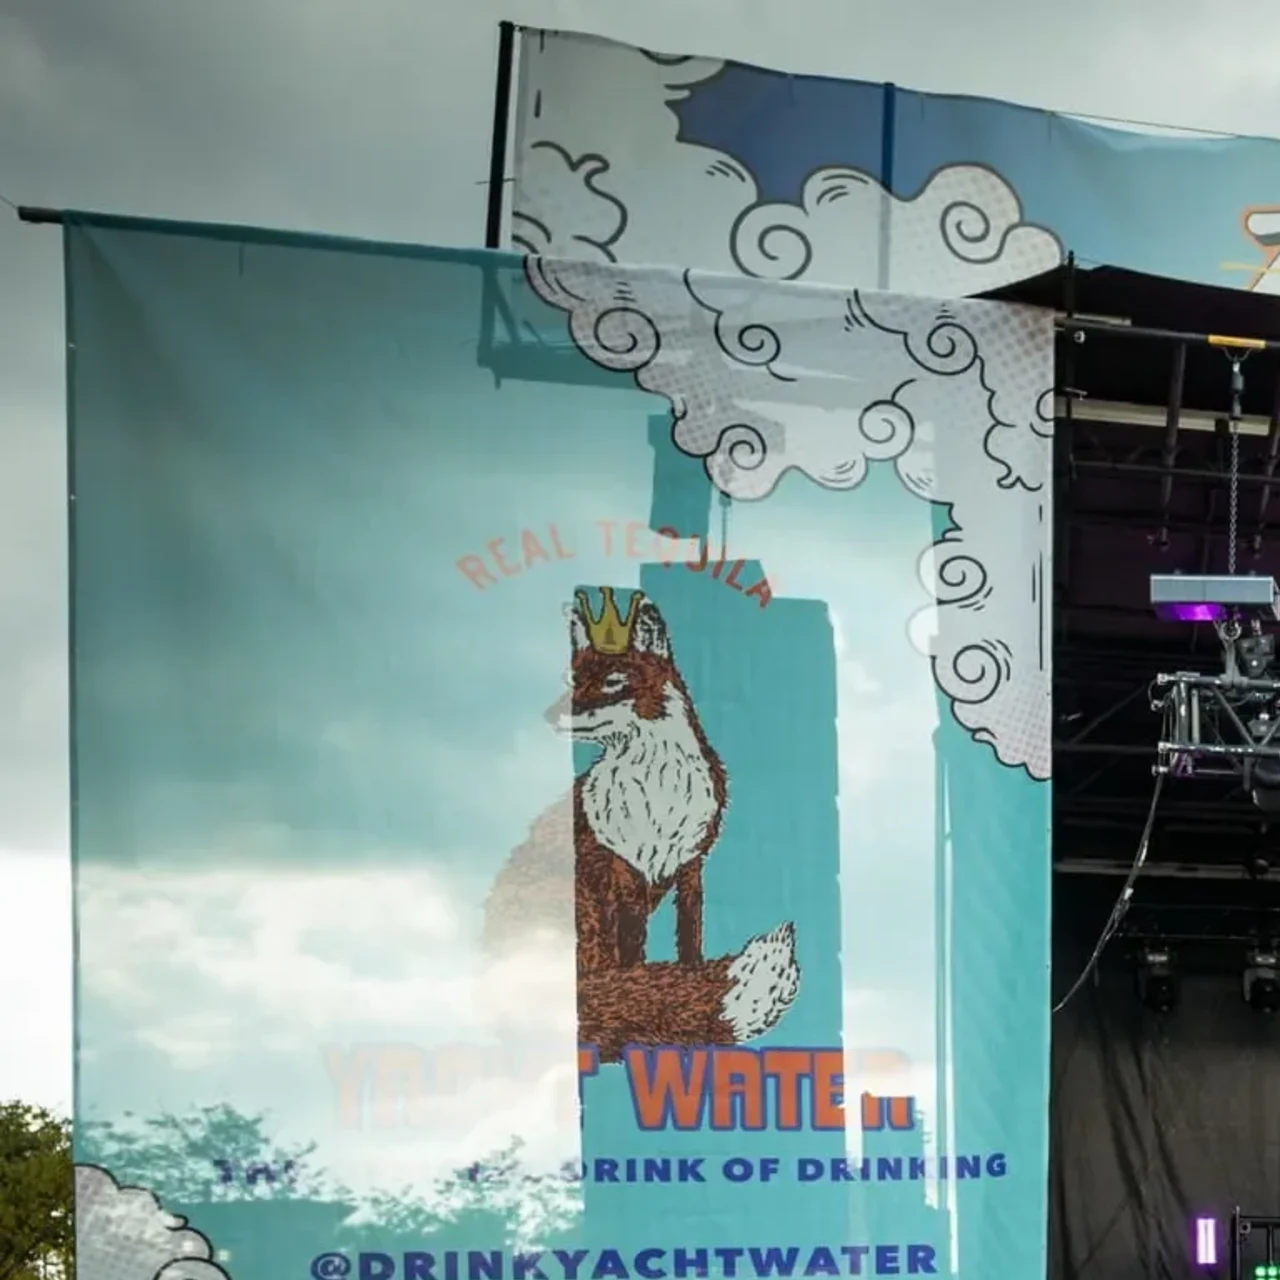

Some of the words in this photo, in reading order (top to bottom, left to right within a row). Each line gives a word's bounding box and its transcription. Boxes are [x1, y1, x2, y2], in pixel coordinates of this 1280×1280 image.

[456, 523, 577, 592] REAL
[595, 520, 775, 609] TEQUILA
[624, 1043, 918, 1132] WATER
[722, 1156, 780, 1183] OF
[797, 1152, 1007, 1183] DRINKING
